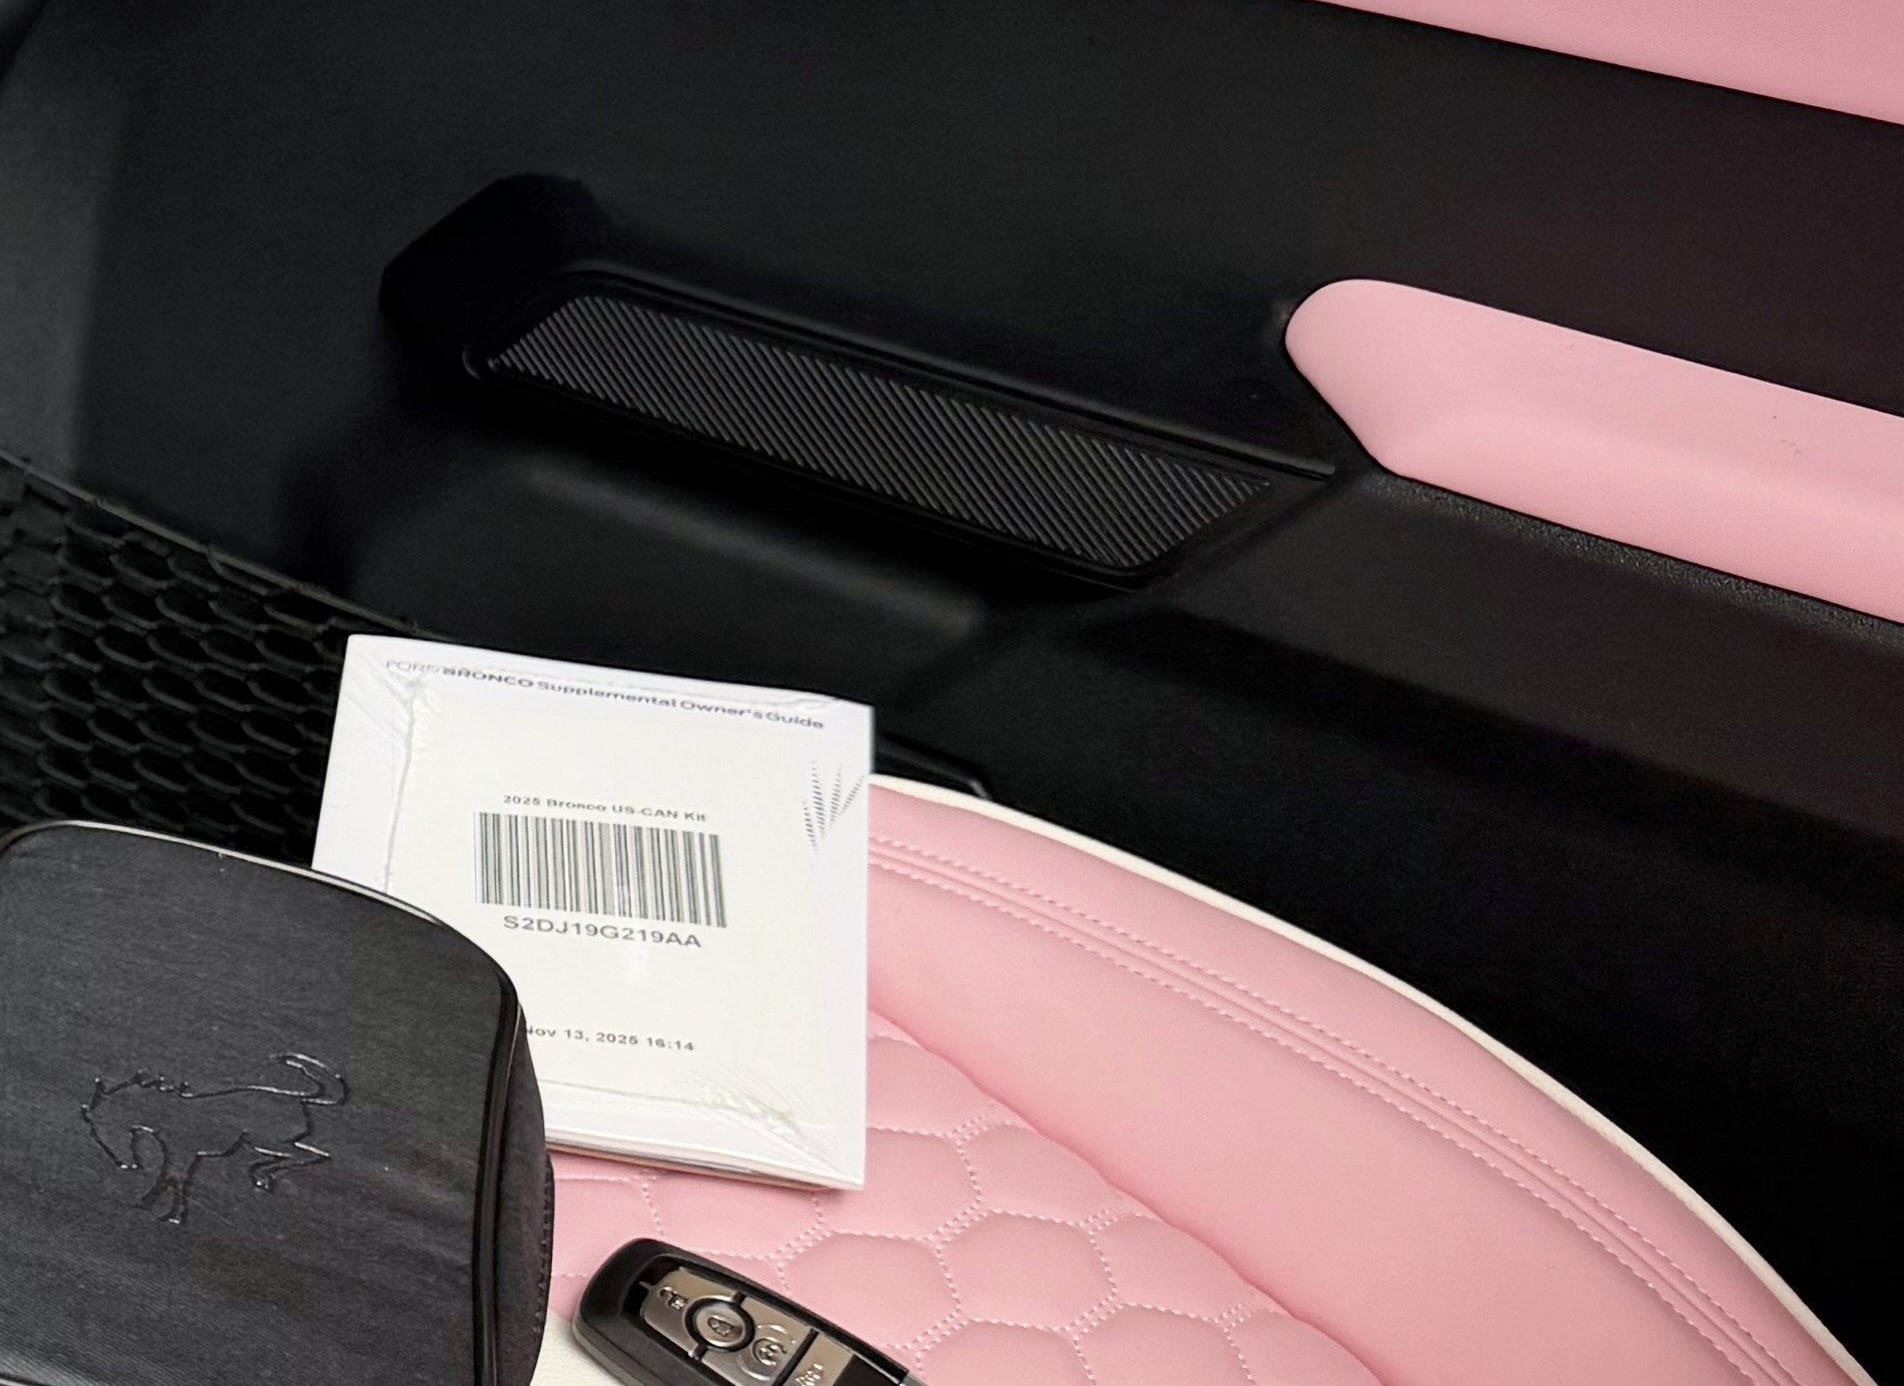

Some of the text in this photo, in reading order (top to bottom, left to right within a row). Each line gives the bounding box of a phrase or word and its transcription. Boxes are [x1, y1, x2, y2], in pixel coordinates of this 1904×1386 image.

[442, 666, 534, 689] BRONCO
[537, 680, 677, 709] Supplemental
[680, 699, 763, 720] Owner's
[765, 712, 824, 729] Guide
[547, 798, 607, 812] Bronco
[684, 808, 707, 823] Kit
[503, 915, 702, 948] S2DJ19G219AA
[564, 1029, 590, 1042] 13,
